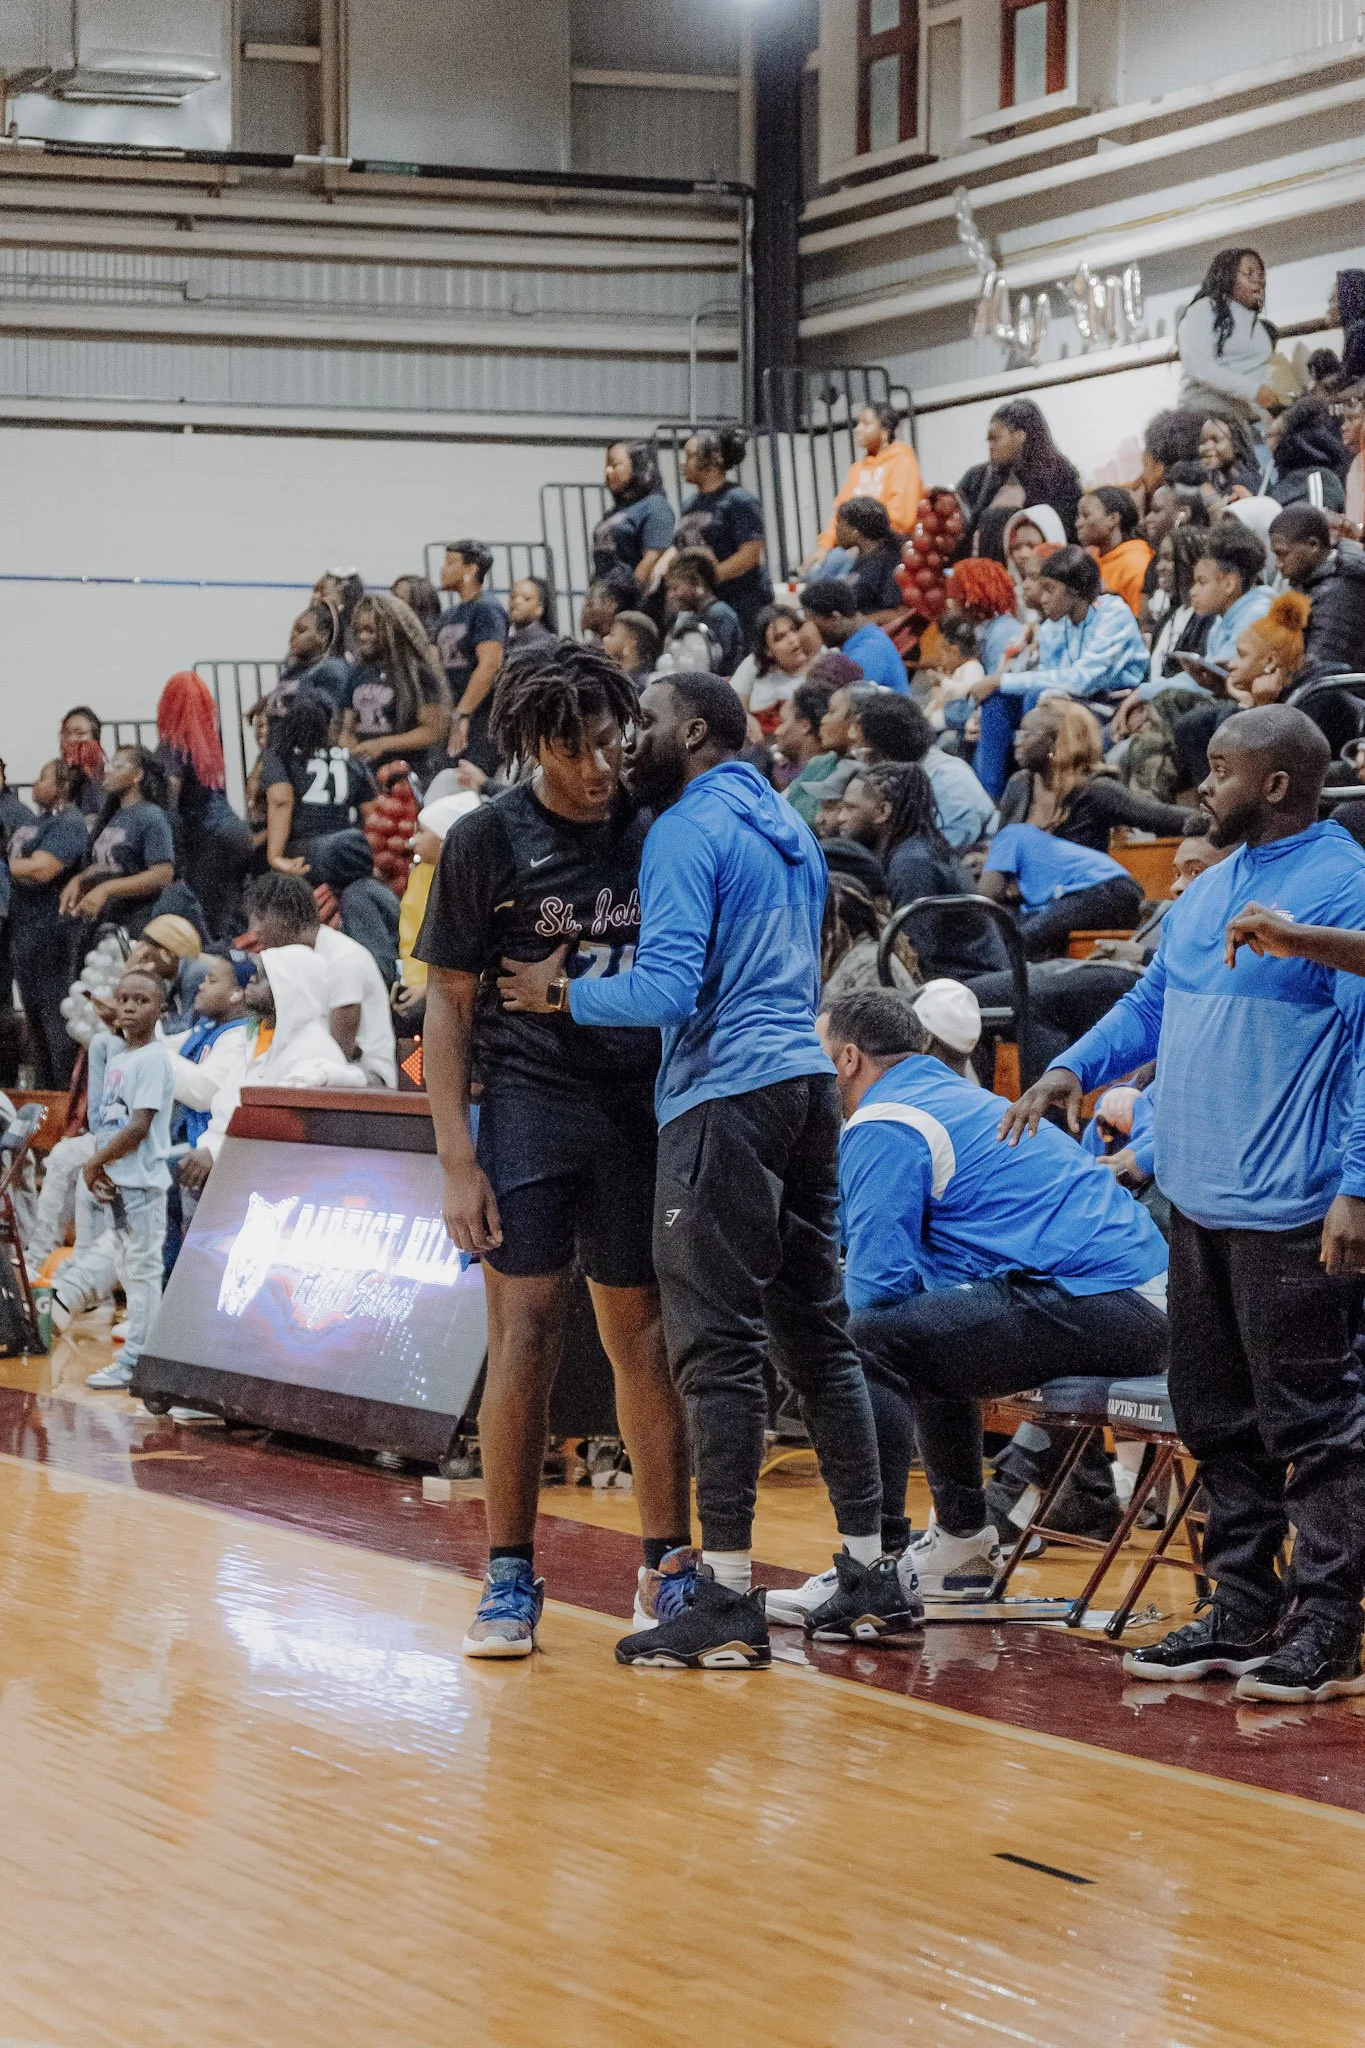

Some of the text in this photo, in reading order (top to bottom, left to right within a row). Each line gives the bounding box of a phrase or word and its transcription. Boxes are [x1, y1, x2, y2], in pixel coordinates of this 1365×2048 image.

[302, 757, 349, 805] 21
[535, 887, 641, 937] St. Joh
[1107, 1398, 1163, 1422] APTIST HILL
